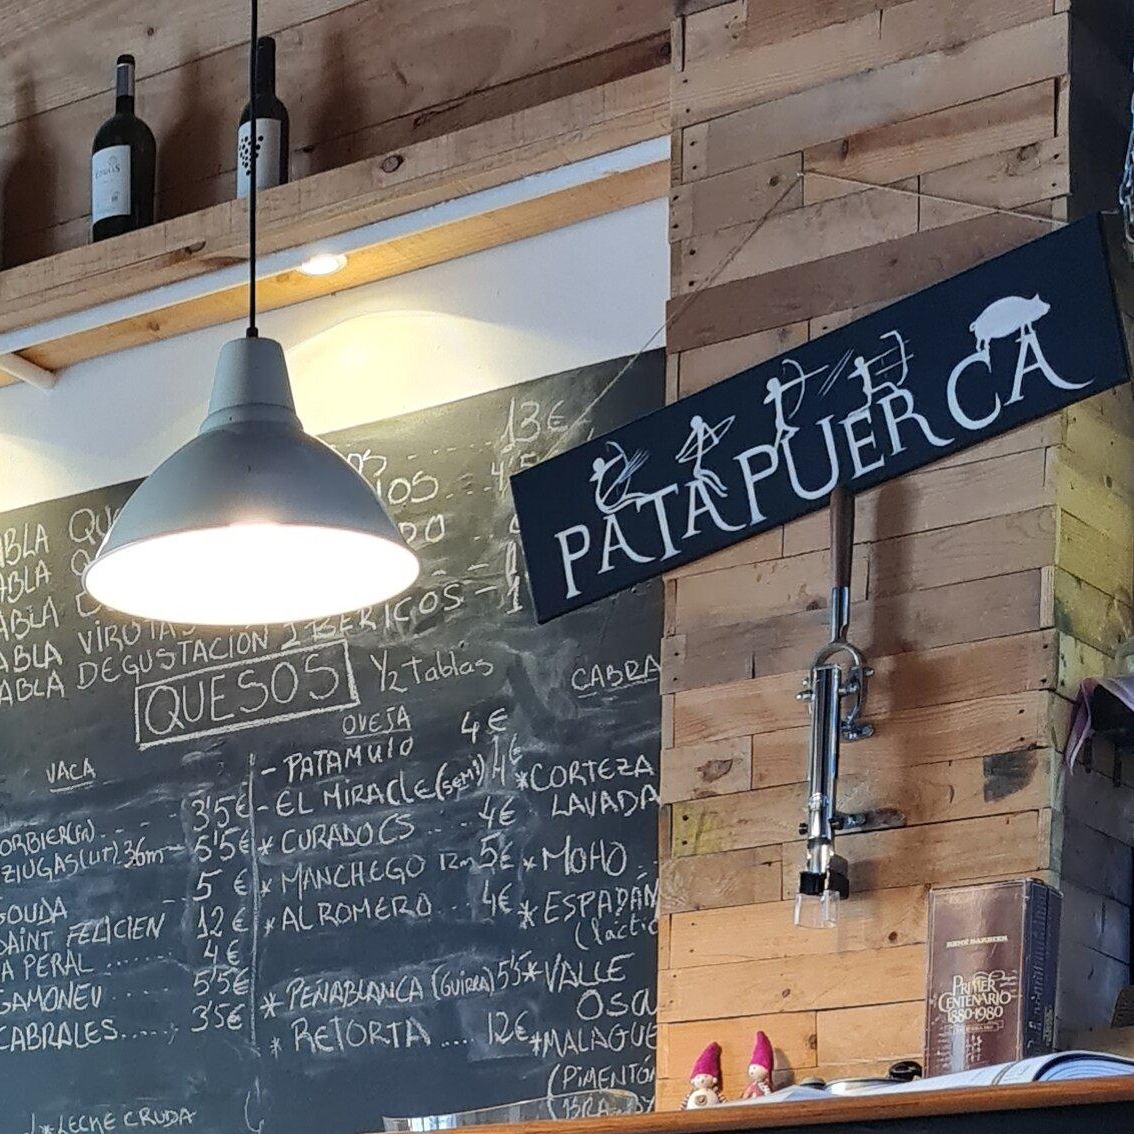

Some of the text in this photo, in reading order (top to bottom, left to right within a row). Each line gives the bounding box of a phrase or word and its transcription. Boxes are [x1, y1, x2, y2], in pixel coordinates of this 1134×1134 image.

[554, 331, 1096, 601] PATAPUERCA
[77, 619, 197, 655] VIROTA
[570, 654, 662, 692] CABRA
[144, 652, 340, 736] QUESOS
[342, 704, 411, 738] OVEJA
[46, 756, 97, 786] VACA
[530, 753, 656, 793] CORTEZA
[275, 790, 314, 817] EL
[551, 783, 663, 819] LAVADA
[541, 835, 628, 877] MOHO
[281, 854, 426, 901] MANCHEGO
[319, 892, 432, 927] ROMERO
[66, 913, 167, 948] FELICIEN
[23, 949, 94, 979] PERAL
[545, 951, 636, 994] VALLE
[938, 990, 1012, 1013] CENTENARIO
[952, 975, 998, 997] PRIMER
[291, 1014, 432, 1053] RETORTA
[123, 1106, 198, 1128] CRUDA
